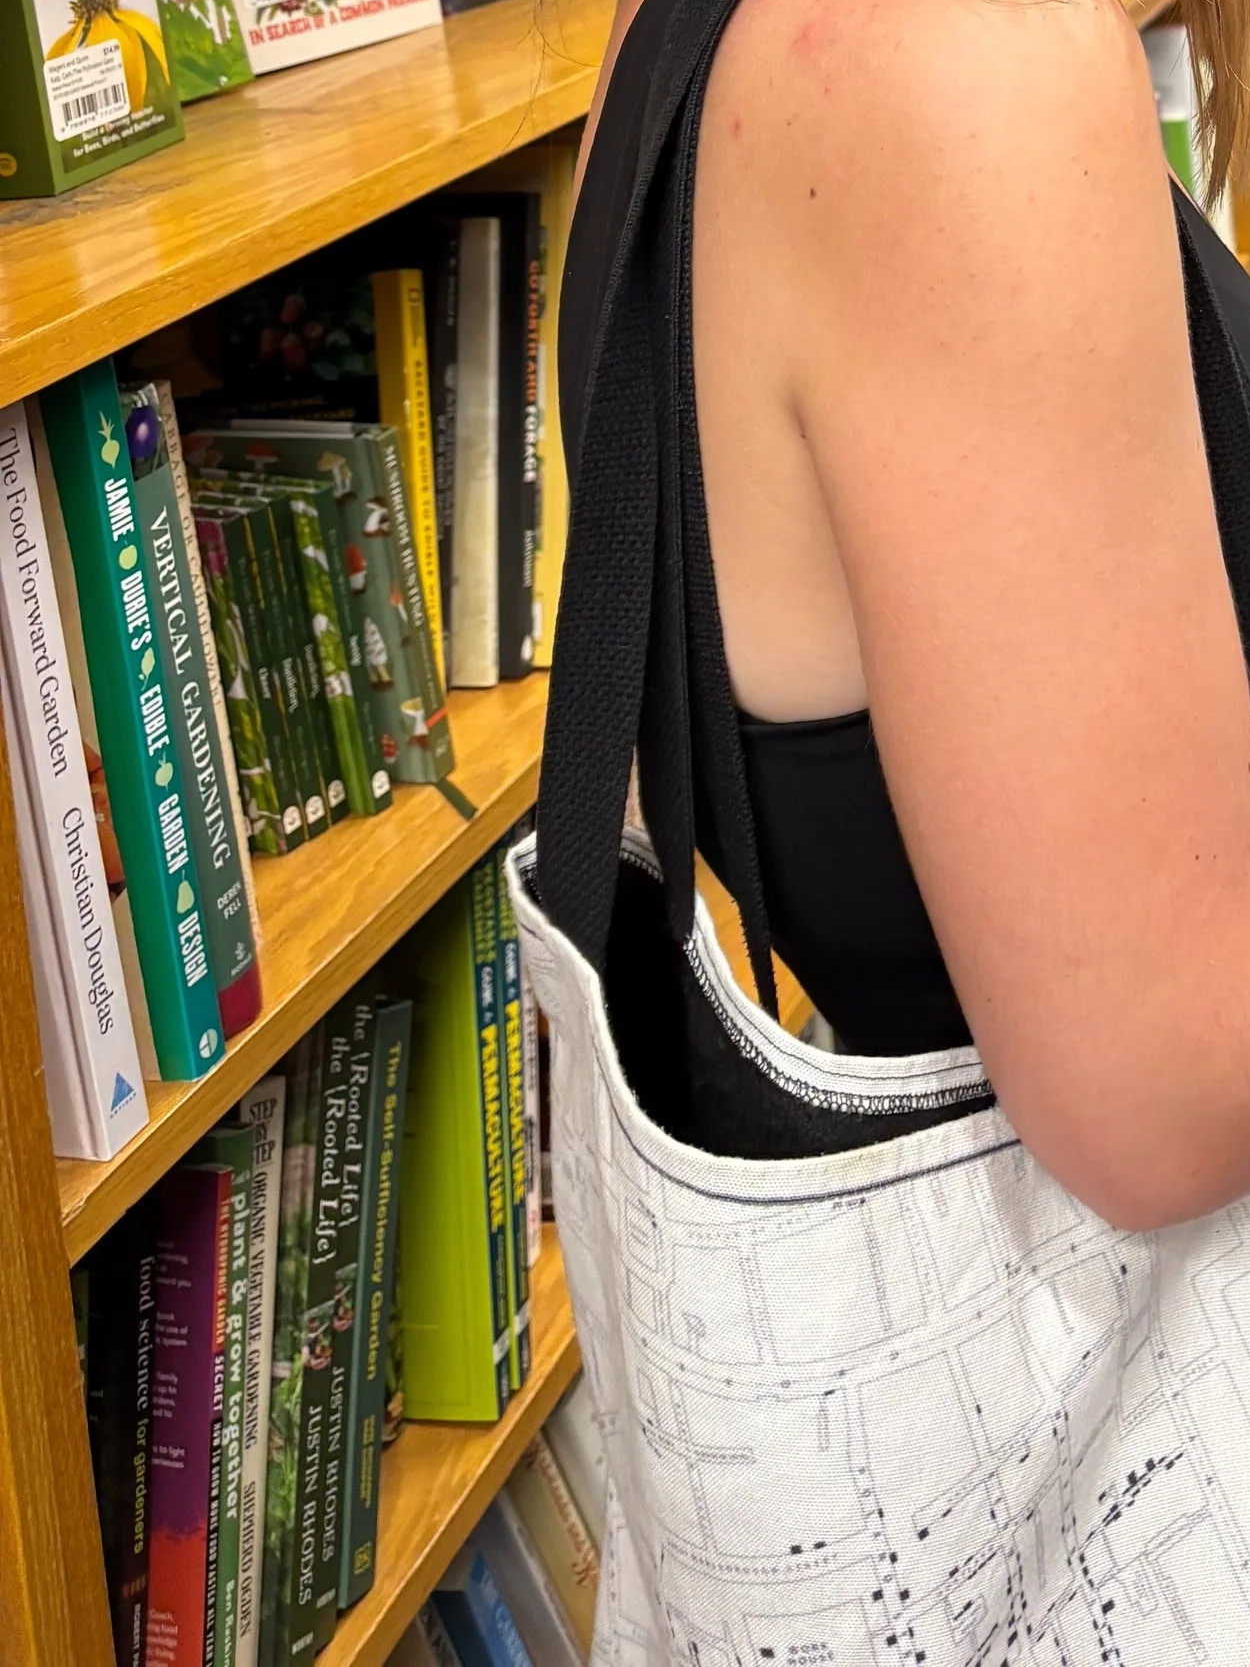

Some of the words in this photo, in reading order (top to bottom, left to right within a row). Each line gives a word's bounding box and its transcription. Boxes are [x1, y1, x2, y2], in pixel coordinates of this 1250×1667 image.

[248, 28, 265, 46] IN
[267, 17, 312, 41] SEARCH
[312, 13, 327, 30] OF
[329, 10, 339, 26] A
[133, 114, 165, 133] Butterflies
[0, 427, 22, 483] The
[160, 390, 188, 515] CABBAGE
[523, 404, 539, 483] FORAGE
[6, 485, 37, 555] Food
[384, 443, 411, 545] MUSHROOM
[400, 549, 425, 627] HUNTING
[18, 553, 56, 673] Forward
[149, 506, 185, 675] VERTICAL
[180, 682, 232, 871] GARDENING
[38, 675, 70, 779] Garden
[104, 477, 136, 543] JAMIE
[120, 569, 153, 651] DURIE'S
[138, 684, 171, 758] EDIBLE
[157, 794, 190, 875] GARDEN
[176, 910, 209, 988] DESIGN
[61, 806, 95, 932] Christian
[216, 881, 243, 911] DEREK
[223, 897, 243, 920] FELL
[83, 926, 116, 1036] Douglas
[330, 1036, 350, 1074] the
[355, 1004, 373, 1041] the
[387, 1041, 402, 1088] The
[249, 1097, 278, 1120] STEP
[254, 1120, 269, 1143] BY
[481, 1023, 505, 1233] PERMACULTURE
[505, 999, 525, 1205] PERMACULTURE
[251, 1172, 267, 1246] ORGANIC
[371, 1093, 397, 1284] Self-Sufficiency
[216, 1224, 228, 1295] HYDROPONIC
[230, 1191, 250, 1270] plant
[137, 1255, 156, 1313] food
[230, 1280, 248, 1305] &
[247, 1250, 265, 1345] VEGETABLE
[215, 1298, 227, 1345] GARDEN
[226, 1313, 247, 1382] grow
[366, 1290, 386, 1380] Garden
[135, 1318, 155, 1413] science
[213, 1355, 225, 1412] SECRET
[244, 1348, 261, 1451] GARDENING
[135, 1417, 150, 1448] for
[212, 1422, 222, 1446] HOW
[326, 1365, 345, 1454] JUSTIN
[210, 1466, 220, 1497] GROW
[221, 1390, 242, 1520] together
[305, 1405, 322, 1495] JUSTIN
[133, 1451, 148, 1555] gardeners
[209, 1499, 219, 1531] MORE
[240, 1480, 256, 1567] SHEPHERD
[321, 1458, 339, 1563] RHODES
[208, 1532, 218, 1562] FOOD
[298, 1501, 318, 1606] RHODES
[132, 1602, 142, 1650] ROBERT
[224, 1580, 235, 1605] Ben
[238, 1572, 253, 1639] OGDEN
